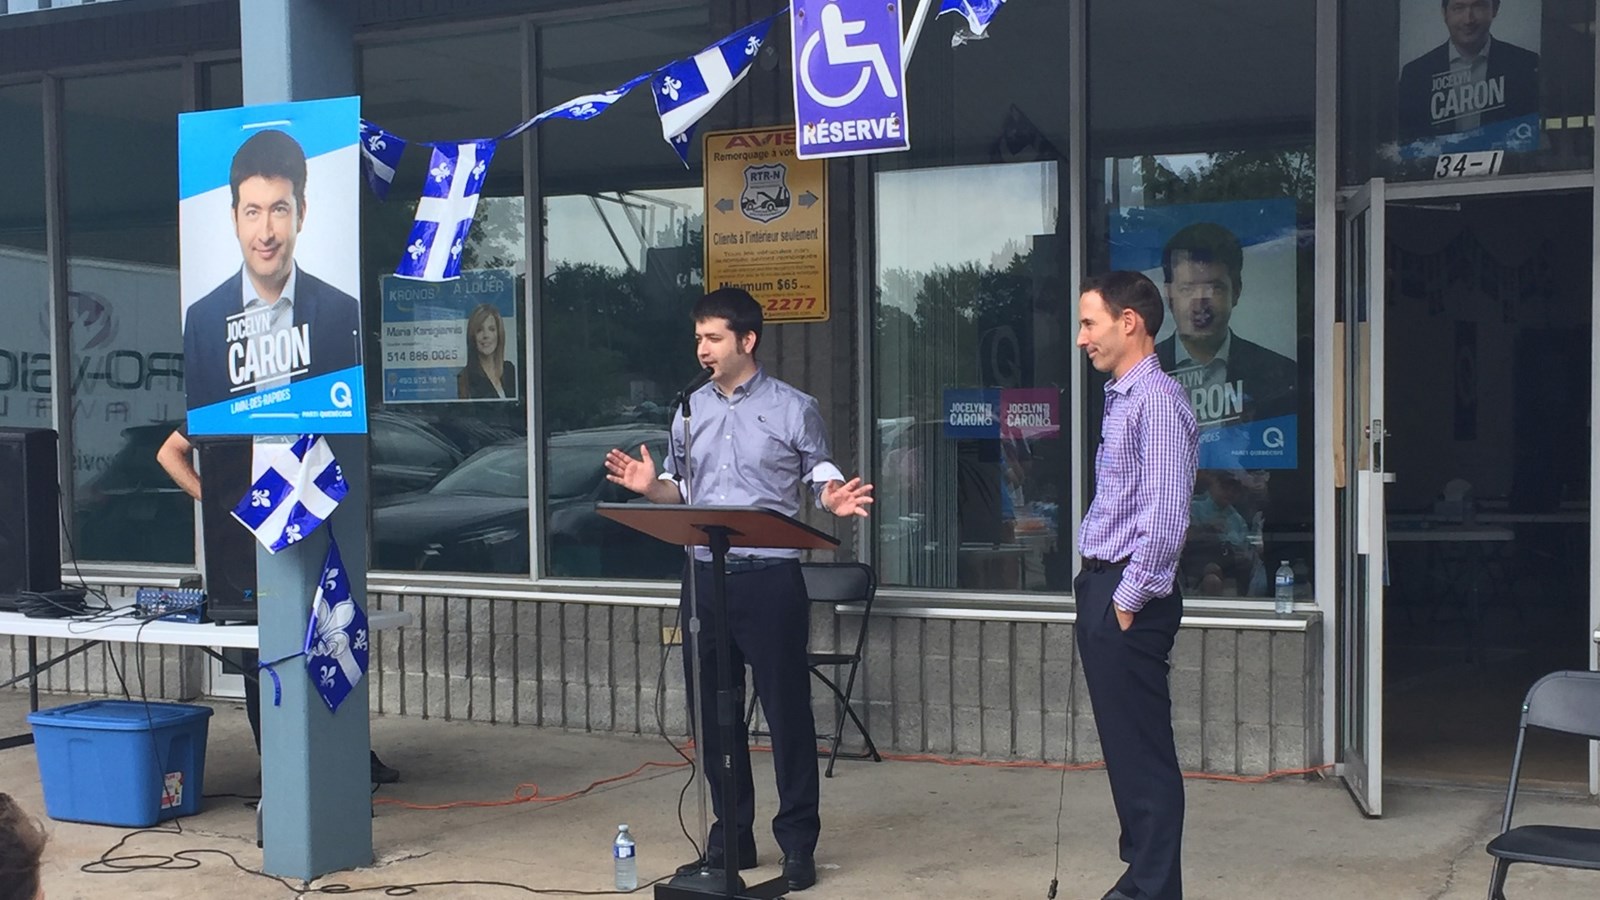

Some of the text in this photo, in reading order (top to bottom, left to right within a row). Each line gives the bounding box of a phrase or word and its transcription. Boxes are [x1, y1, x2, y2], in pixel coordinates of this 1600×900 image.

[1432, 69, 1471, 92] JOCELYN
[1431, 75, 1504, 120] CARON
[803, 112, 900, 145] RÉSERVÉ
[725, 132, 796, 149] AVIS
[714, 150, 769, 161] Remorquage
[750, 171, 780, 181] RTR-N
[713, 232, 737, 245] Clients
[781, 228, 818, 241] seulement
[465, 280, 504, 294] LOUER
[720, 281, 773, 291] Minimum
[777, 279, 798, 290] $65
[389, 288, 435, 301] KRONOS
[226, 312, 271, 342] JOCELYN
[386, 327, 411, 337] Maria
[228, 323, 311, 385] CARON
[230, 388, 291, 414] LAVAL-DES-RAPIDES
[330, 381, 352, 408] Q
[1191, 380, 1243, 420] RON
[950, 403, 985, 413] JOCELYN
[1006, 403, 1042, 413] JOCELYN
[950, 413, 985, 426] CARON
[1006, 414, 1042, 427] CARON
[1262, 426, 1284, 448] Q
